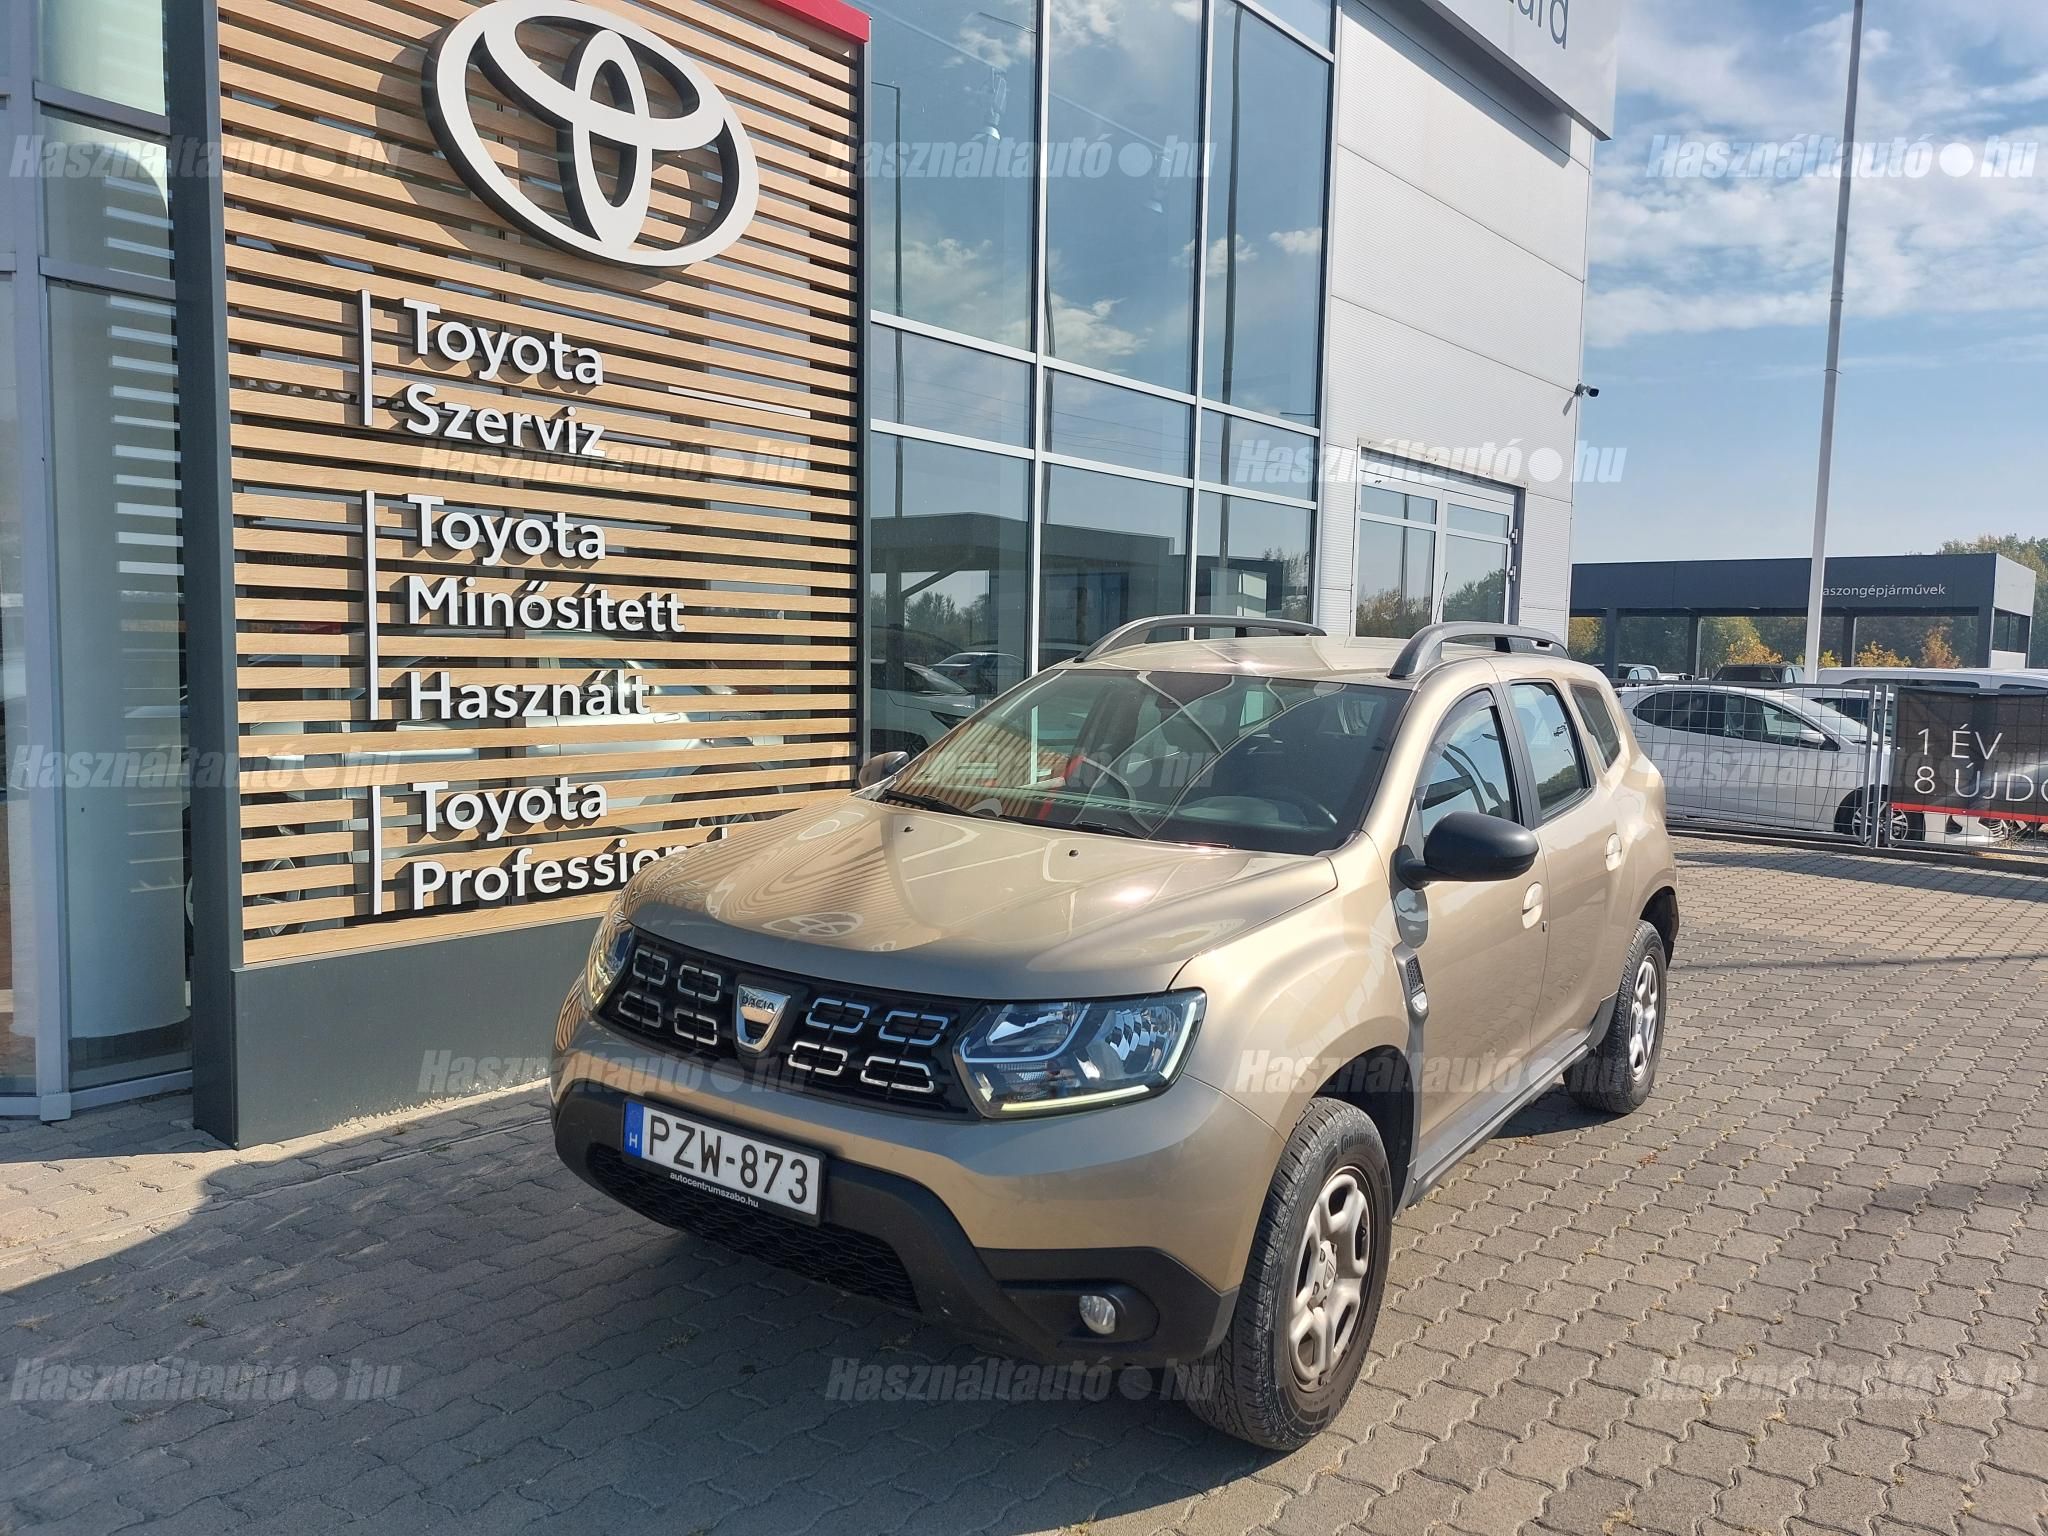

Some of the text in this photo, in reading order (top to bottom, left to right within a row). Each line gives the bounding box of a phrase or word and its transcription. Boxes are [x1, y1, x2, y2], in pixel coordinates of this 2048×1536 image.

[404, 298, 604, 385] Toyota
[407, 383, 607, 457] Szerviz
[408, 494, 606, 566] Toyota
[409, 575, 686, 632] Minősített
[1822, 583, 1946, 598] aszongépjárművek
[410, 669, 651, 720] Használt
[1917, 723, 2003, 760] 1 ÉV
[1914, 765, 1936, 794] 8
[413, 776, 608, 842] Toyota
[413, 827, 729, 910] Professio
[742, 996, 776, 1013] DACIA
[629, 1132, 638, 1149] H
[649, 1114, 808, 1205] PZW-873
[669, 1171, 759, 1208] autocentrumszabo.hu
